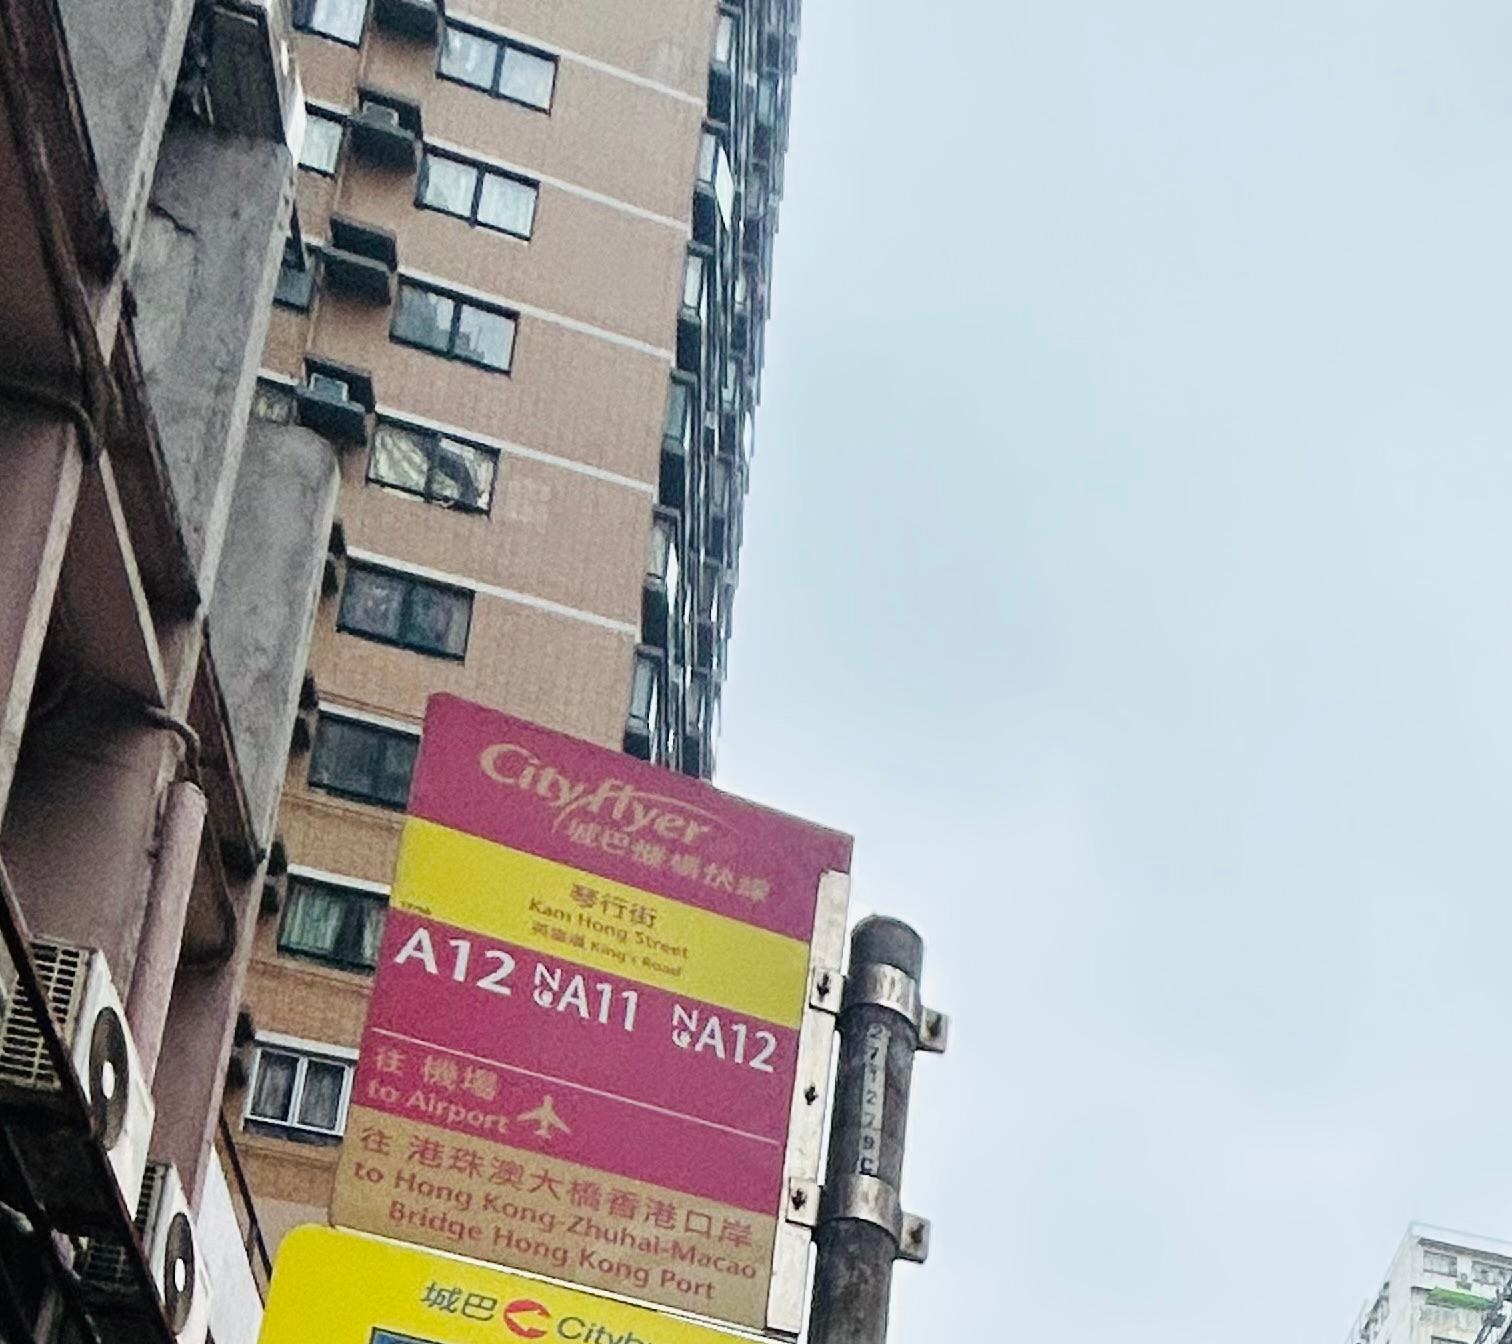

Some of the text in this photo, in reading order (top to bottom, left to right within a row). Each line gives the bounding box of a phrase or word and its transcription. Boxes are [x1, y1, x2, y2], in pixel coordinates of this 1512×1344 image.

[528, 897, 690, 960] Kam Hong Street
[570, 883, 658, 930] 琴行街
[394, 926, 516, 997] A12
[374, 1048, 499, 1101] 往 機場
[367, 1078, 511, 1135] to Airport
[360, 1125, 755, 1250] 往 港珠澳大橋香港口岸
[353, 1161, 758, 1281] to Hong Kong-Zhuhai-Macao
[388, 1199, 717, 1299] Bridge Hong Kong Port
[420, 1280, 499, 1322] 城巴
